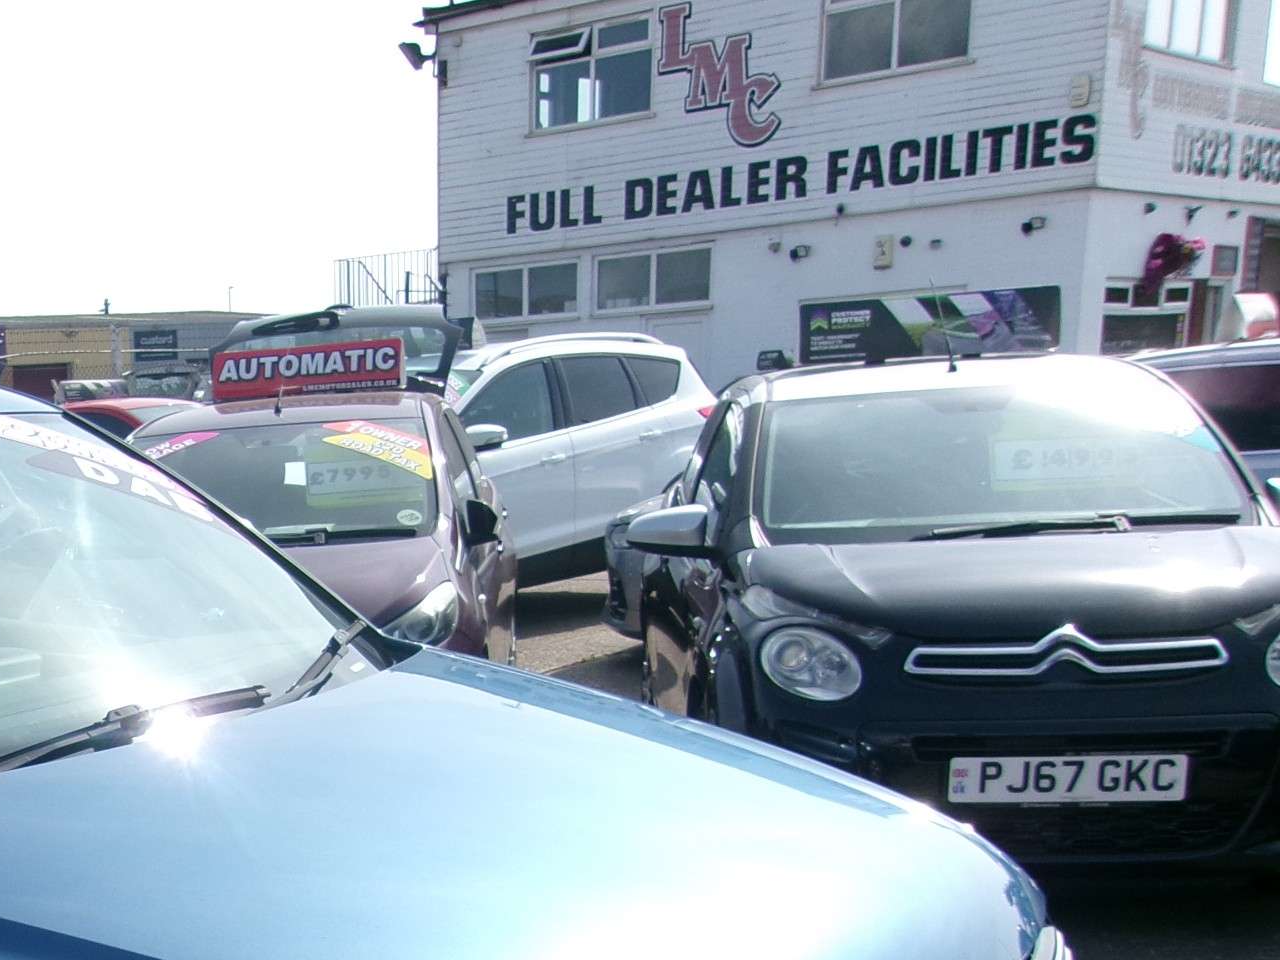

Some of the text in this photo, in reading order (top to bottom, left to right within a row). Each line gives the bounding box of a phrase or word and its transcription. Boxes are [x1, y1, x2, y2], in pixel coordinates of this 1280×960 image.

[657, 1, 781, 148] LMC
[506, 113, 1097, 234] FULL DEALER FACILITIES
[219, 347, 396, 382] AUTOMATIC
[340, 438, 385, 457] ROAD
[362, 426, 423, 450] OWNER
[979, 760, 1086, 794] PJ67
[1097, 758, 1177, 793] GKC
